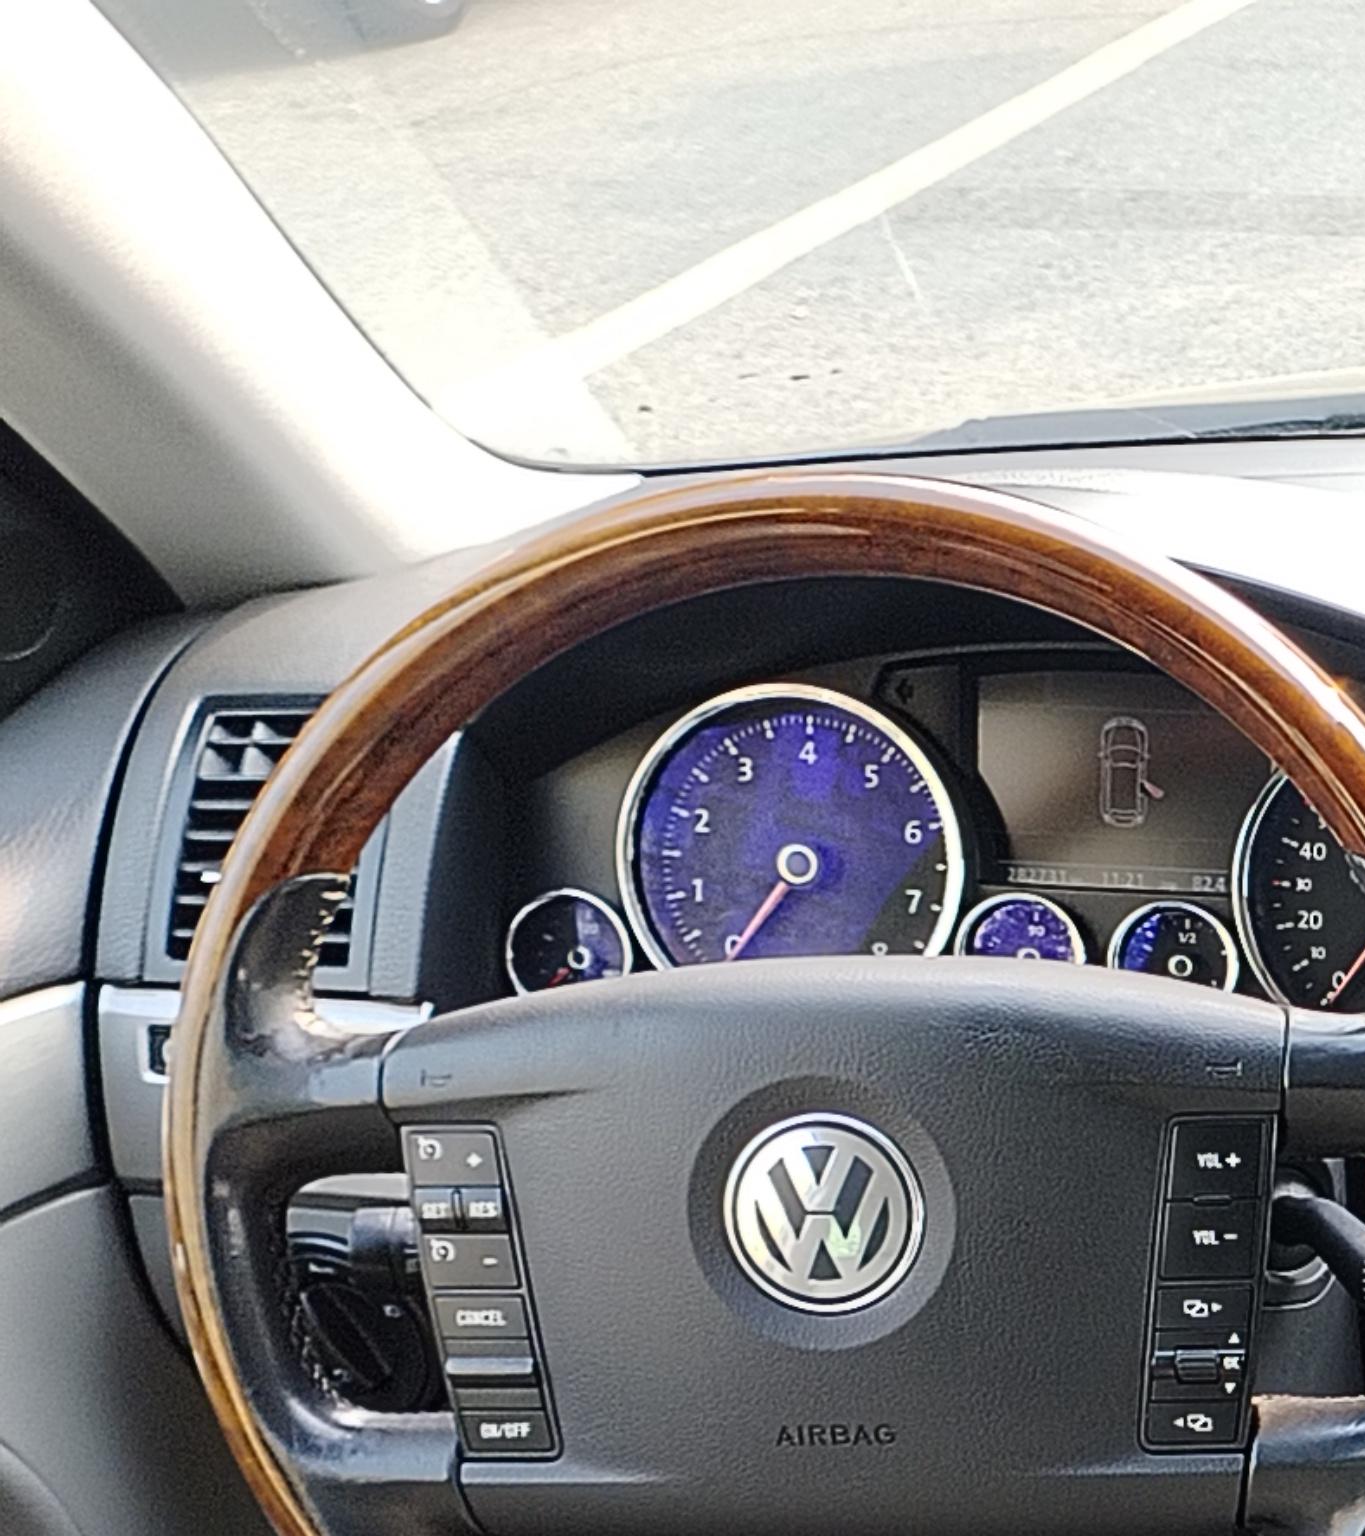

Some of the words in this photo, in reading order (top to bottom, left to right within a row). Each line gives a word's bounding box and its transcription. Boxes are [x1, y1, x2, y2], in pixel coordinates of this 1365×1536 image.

[799, 741, 818, 765] 4
[738, 757, 753, 782] 3
[864, 765, 880, 789] 5
[693, 809, 711, 834] 2
[904, 821, 922, 845] 6
[1299, 841, 1327, 861] 40
[693, 877, 704, 902] 1
[905, 890, 922, 914] 7
[1297, 911, 1323, 931] 20
[1310, 946, 1326, 960] 10
[1197, 1152, 1223, 1169] VOL
[1192, 1230, 1220, 1246] VOL
[775, 1422, 897, 1448] AIRBAG
